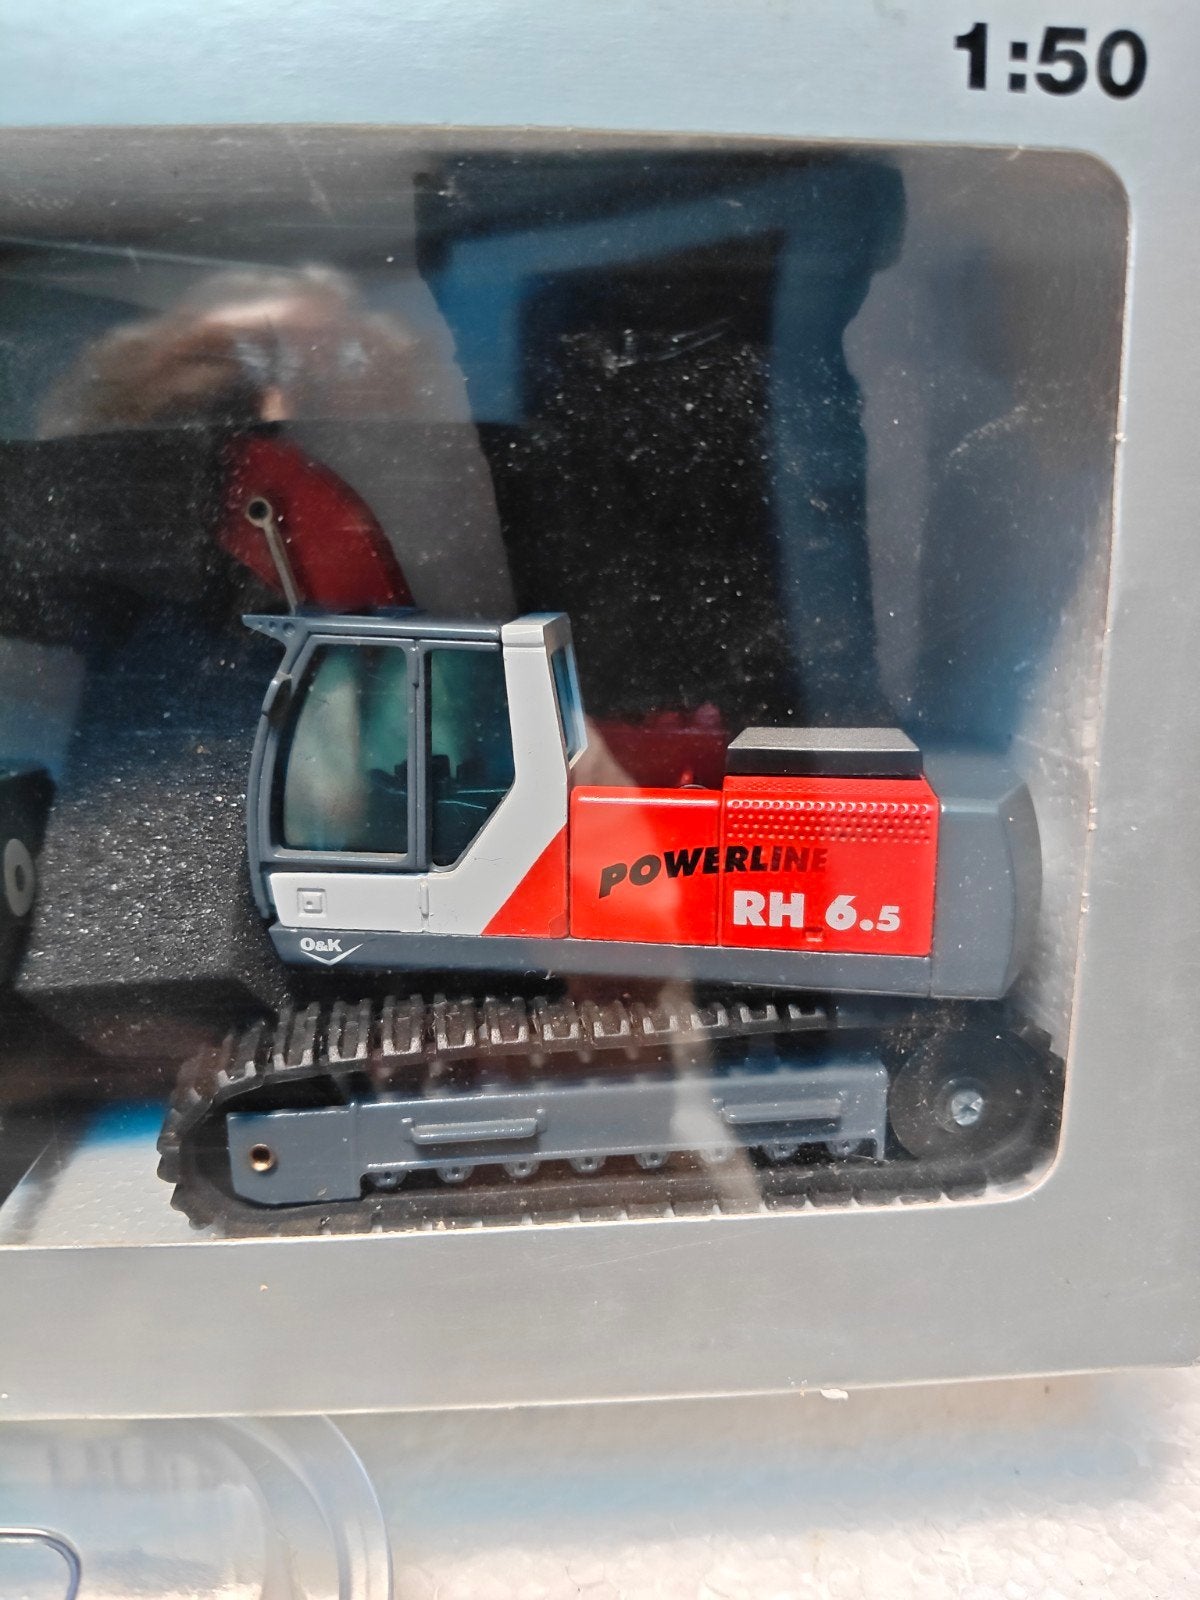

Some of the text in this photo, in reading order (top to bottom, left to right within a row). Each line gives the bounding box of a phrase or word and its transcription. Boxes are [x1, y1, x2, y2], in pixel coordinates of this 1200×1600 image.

[954, 22, 1148, 101] 1:50
[598, 845, 828, 899] POWERLINE
[733, 890, 901, 932] RH 6.5
[300, 937, 343, 952] O&K
